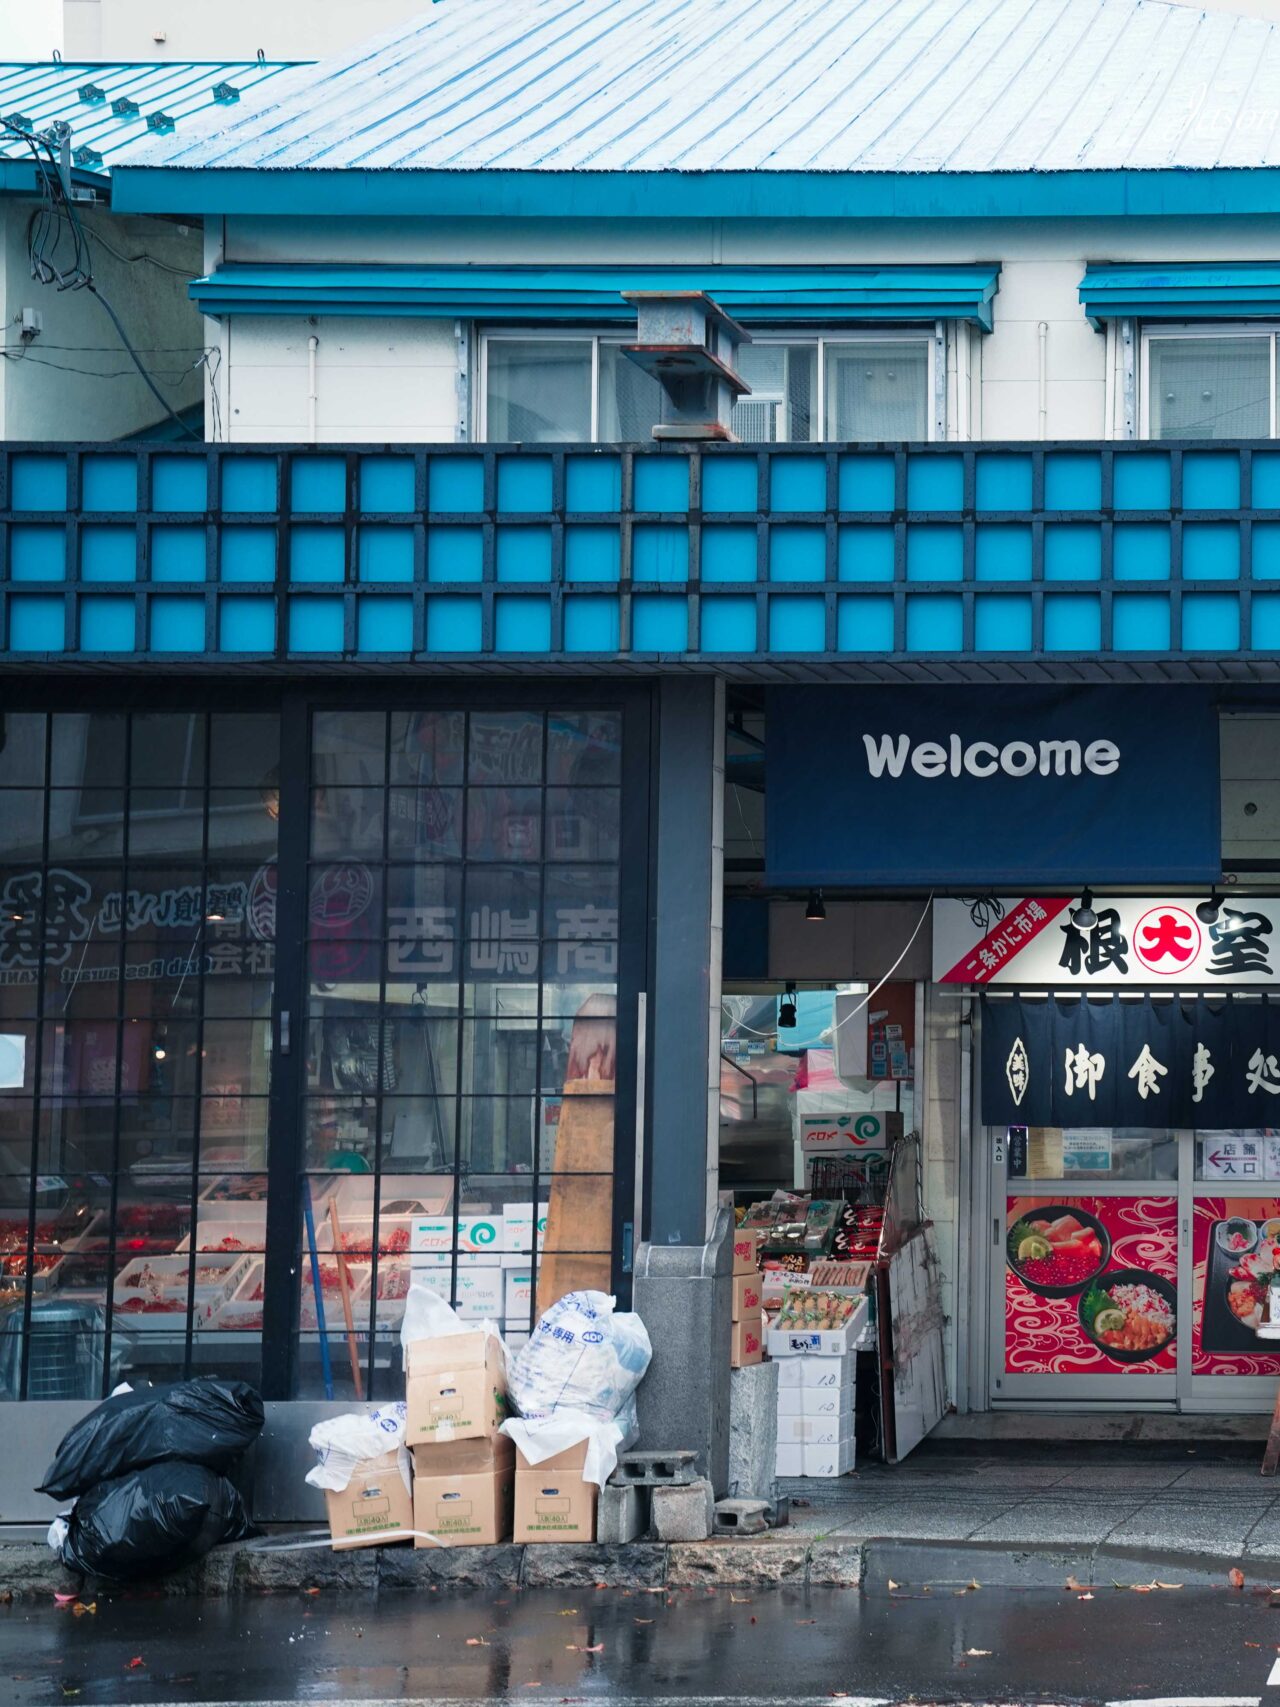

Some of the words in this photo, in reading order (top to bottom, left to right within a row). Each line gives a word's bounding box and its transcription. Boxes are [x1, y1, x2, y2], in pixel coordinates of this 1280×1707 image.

[862, 733, 1121, 778] Welcome
[387, 903, 618, 975] 西嶋商
[963, 899, 1050, 982] 二条かに市場
[1011, 1052, 1026, 1092] 美味
[806, 1131, 839, 1142] メロン
[995, 1137, 1003, 1162] 出入口
[1223, 1143, 1256, 1156] 店舗
[1223, 1162, 1256, 1174] 入口
[817, 1374, 836, 1386] 1.0
[818, 1402, 835, 1411] 1.0
